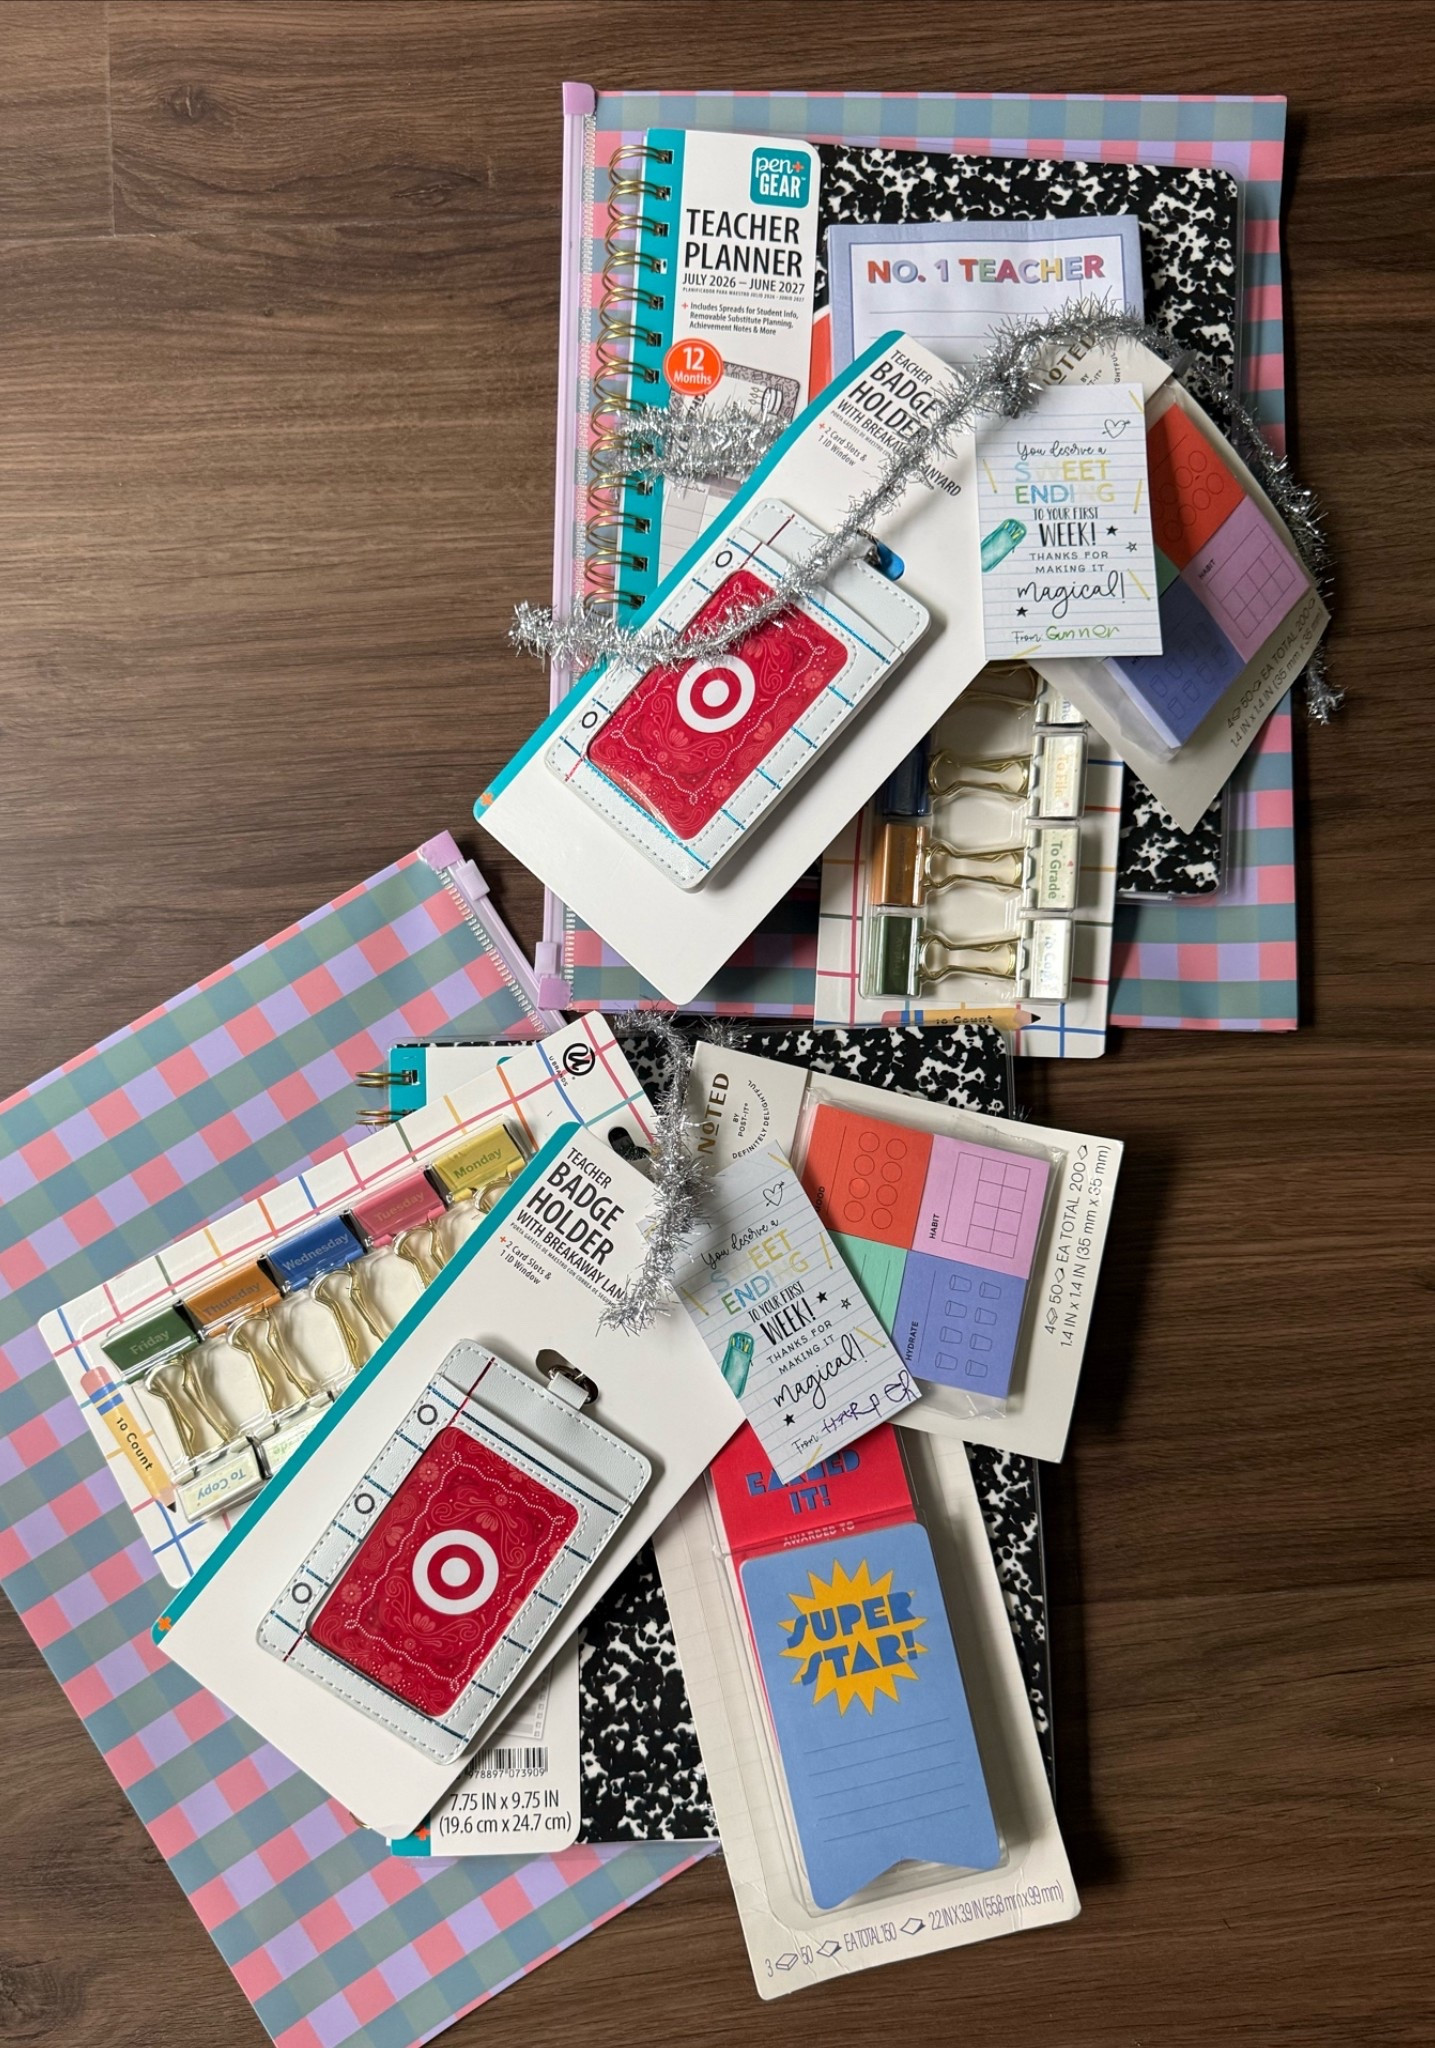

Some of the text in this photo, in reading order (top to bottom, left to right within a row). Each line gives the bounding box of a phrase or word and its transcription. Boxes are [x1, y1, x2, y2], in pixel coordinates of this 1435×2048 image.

[759, 172, 801, 199] GEAR
[686, 208, 800, 245] TEACHER
[685, 241, 803, 278] PLANNER
[867, 254, 1106, 284] NO. 1 TEACHER
[682, 273, 805, 295] JULY 2026 JUNE 2027
[689, 321, 777, 335] Achievement Notes & More
[690, 302, 799, 320] Includes Spreads for Student Info,
[690, 312, 794, 329] Removable Substitute Planning,
[683, 347, 705, 371] 12
[890, 349, 933, 385] TEACHER
[673, 370, 712, 385] Months
[870, 361, 937, 420] BADGE
[1080, 373, 1090, 383] BY
[837, 398, 864, 423] WITH
[822, 437, 831, 448] ID
[830, 443, 856, 467] Window
[824, 427, 868, 462] 2 Card Slots &
[1016, 440, 1107, 461] You deserve a
[1033, 507, 1099, 520] TO YOUR FIRST
[1039, 522, 1097, 547] WEEK!
[1029, 550, 1109, 560] THANKS FOR
[1036, 564, 1105, 574] MAKING IT
[1017, 570, 1126, 619] magical!
[1240, 690, 1254, 709] 50
[1260, 663, 1275, 680] EA
[1272, 631, 1298, 664] TOTAL
[1242, 720, 1252, 735] IN
[1263, 687, 1275, 702] IN
[1272, 669, 1287, 690] (35
[1286, 650, 1300, 671] mm
[1048, 841, 1063, 900] To Grade
[952, 1015, 993, 1024] Count
[551, 1061, 568, 1087] BRANDS
[697, 1072, 730, 1155] NOTED
[732, 1112, 740, 1123] BY
[732, 1079, 770, 1159] DEFINITELY DELIGHTFUL
[452, 1144, 503, 1180] Monday
[566, 1147, 612, 1189] TEACHER
[374, 1189, 425, 1225] Tuesday
[547, 1161, 625, 1231] BADGE
[526, 1186, 615, 1266] HOLDER
[929, 1213, 940, 1240] HABIT
[281, 1233, 349, 1272] Wednesday
[505, 1240, 553, 1280] 2 Card Slots &
[516, 1209, 605, 1284] WITH BREAKAWAY
[701, 1219, 779, 1270] You deserve a
[1044, 1161, 1086, 1335] 4 50 EA TOTAL 200
[1060, 1145, 1112, 1347] 1.4 IN x 1.4 IN (35 mm x 35 mm)
[499, 1249, 541, 1285] 1 ID Window
[202, 1281, 261, 1318] Thursday
[749, 1281, 805, 1323] TO YOUR FIRST
[759, 1297, 816, 1346] WEEK!
[129, 1330, 170, 1355] Friday
[766, 1319, 833, 1364] THANKS FOR
[778, 1334, 836, 1375] MAKING IT
[905, 1320, 919, 1361] HYDRATE
[773, 1333, 868, 1410] magical!
[116, 1417, 153, 1472] 10 Count
[197, 1468, 247, 1500] To Copy
[789, 1484, 831, 1515] IT!
[783, 1520, 856, 1547] AWARDED TO
[787, 1591, 916, 1648] SUPER
[800, 1630, 918, 1686] STAR!
[508, 1767, 545, 1778] 073909
[449, 1789, 559, 1811] 7.75 IN x 9.75 IN
[439, 1810, 572, 1837] (19.6 cm x 24.7 cm)
[765, 1921, 898, 1978] 3 50 EA TOTAL 150
